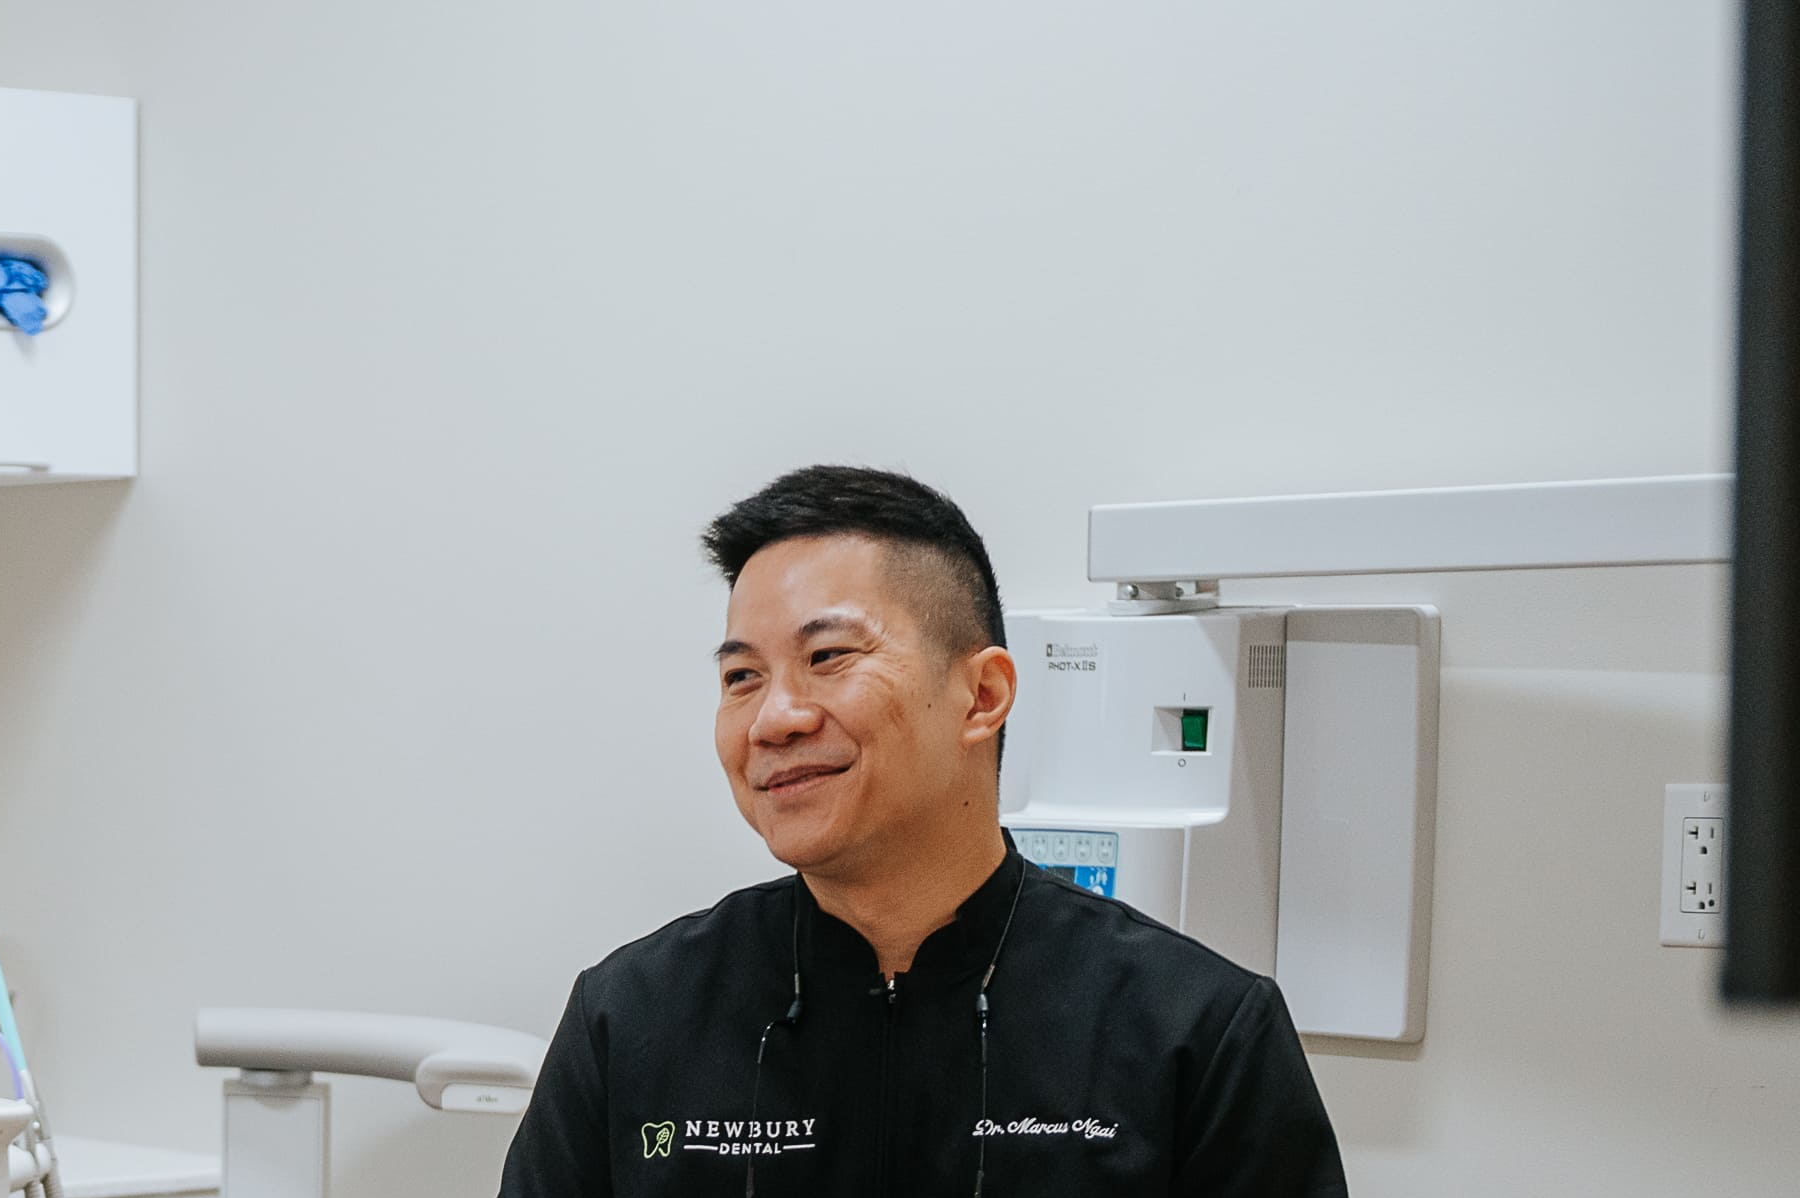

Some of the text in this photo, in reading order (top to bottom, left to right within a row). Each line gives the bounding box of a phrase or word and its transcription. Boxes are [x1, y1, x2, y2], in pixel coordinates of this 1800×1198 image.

[685, 1119, 816, 1138] NEWBURY
[972, 1117, 1119, 1139] Dr. Marcus Ngai
[719, 1142, 782, 1155] DENTAL
